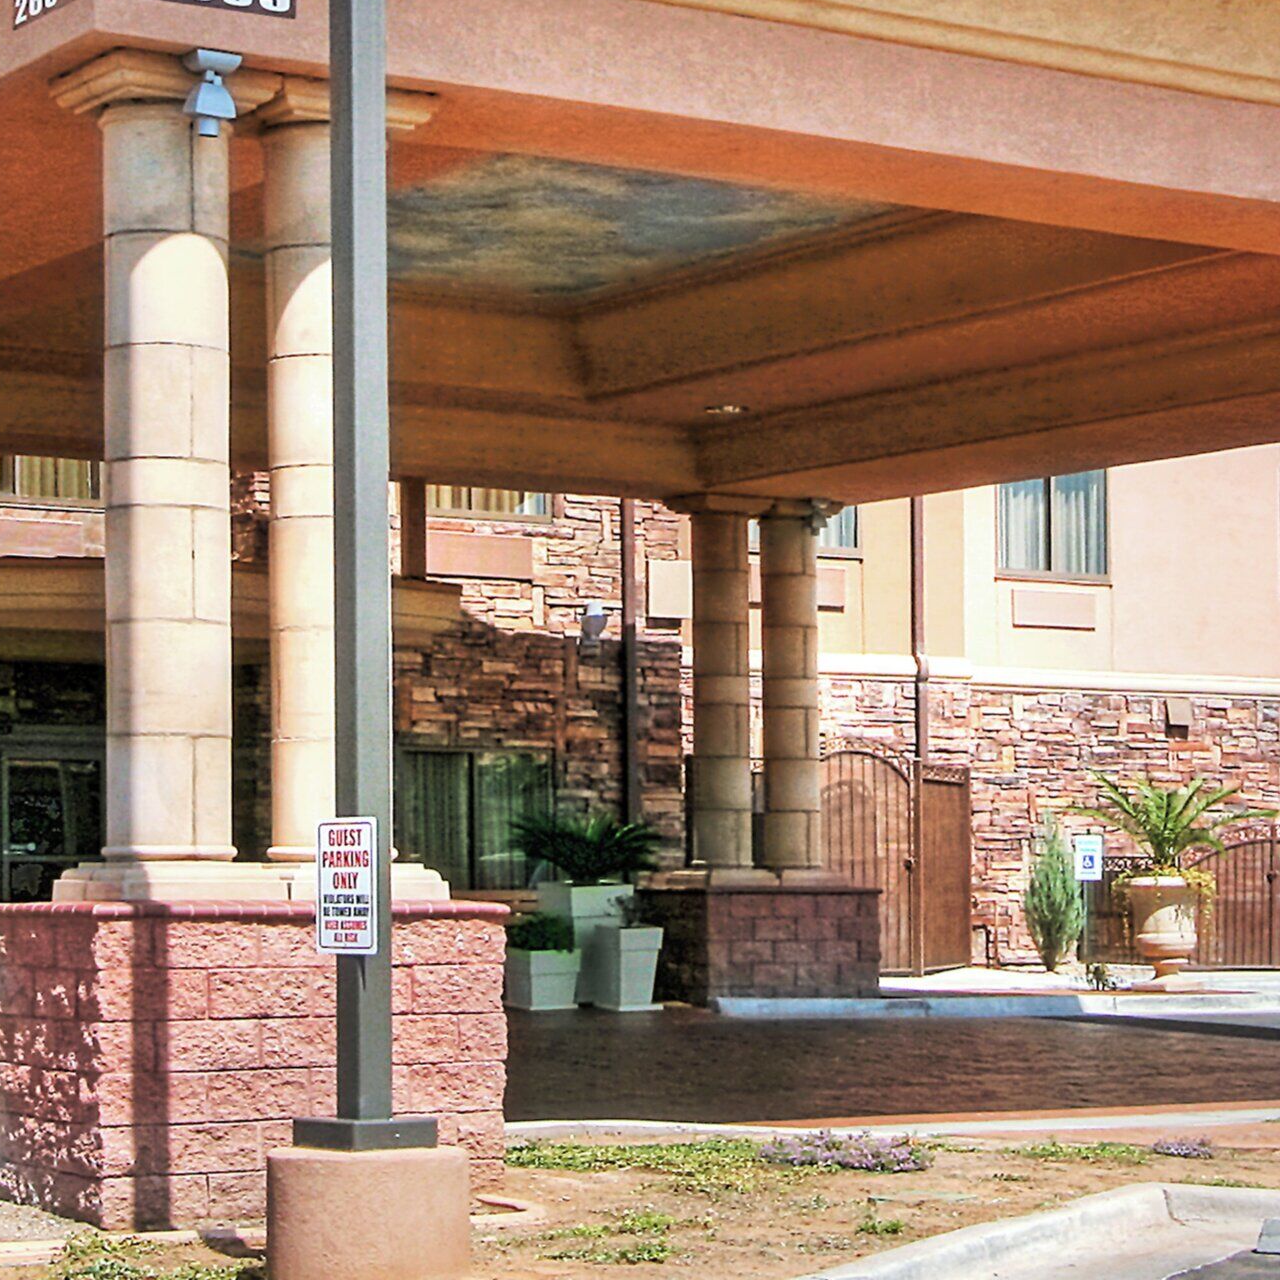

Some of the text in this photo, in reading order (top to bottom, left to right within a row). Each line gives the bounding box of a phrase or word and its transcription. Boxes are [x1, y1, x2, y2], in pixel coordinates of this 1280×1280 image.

[328, 829, 363, 847] GUEST
[322, 850, 370, 868] PARKING
[332, 872, 359, 889] ONLY
[323, 894, 369, 905] VIOLATORS WILL
[332, 907, 352, 917] TOWED
[353, 907, 369, 917] AWAY
